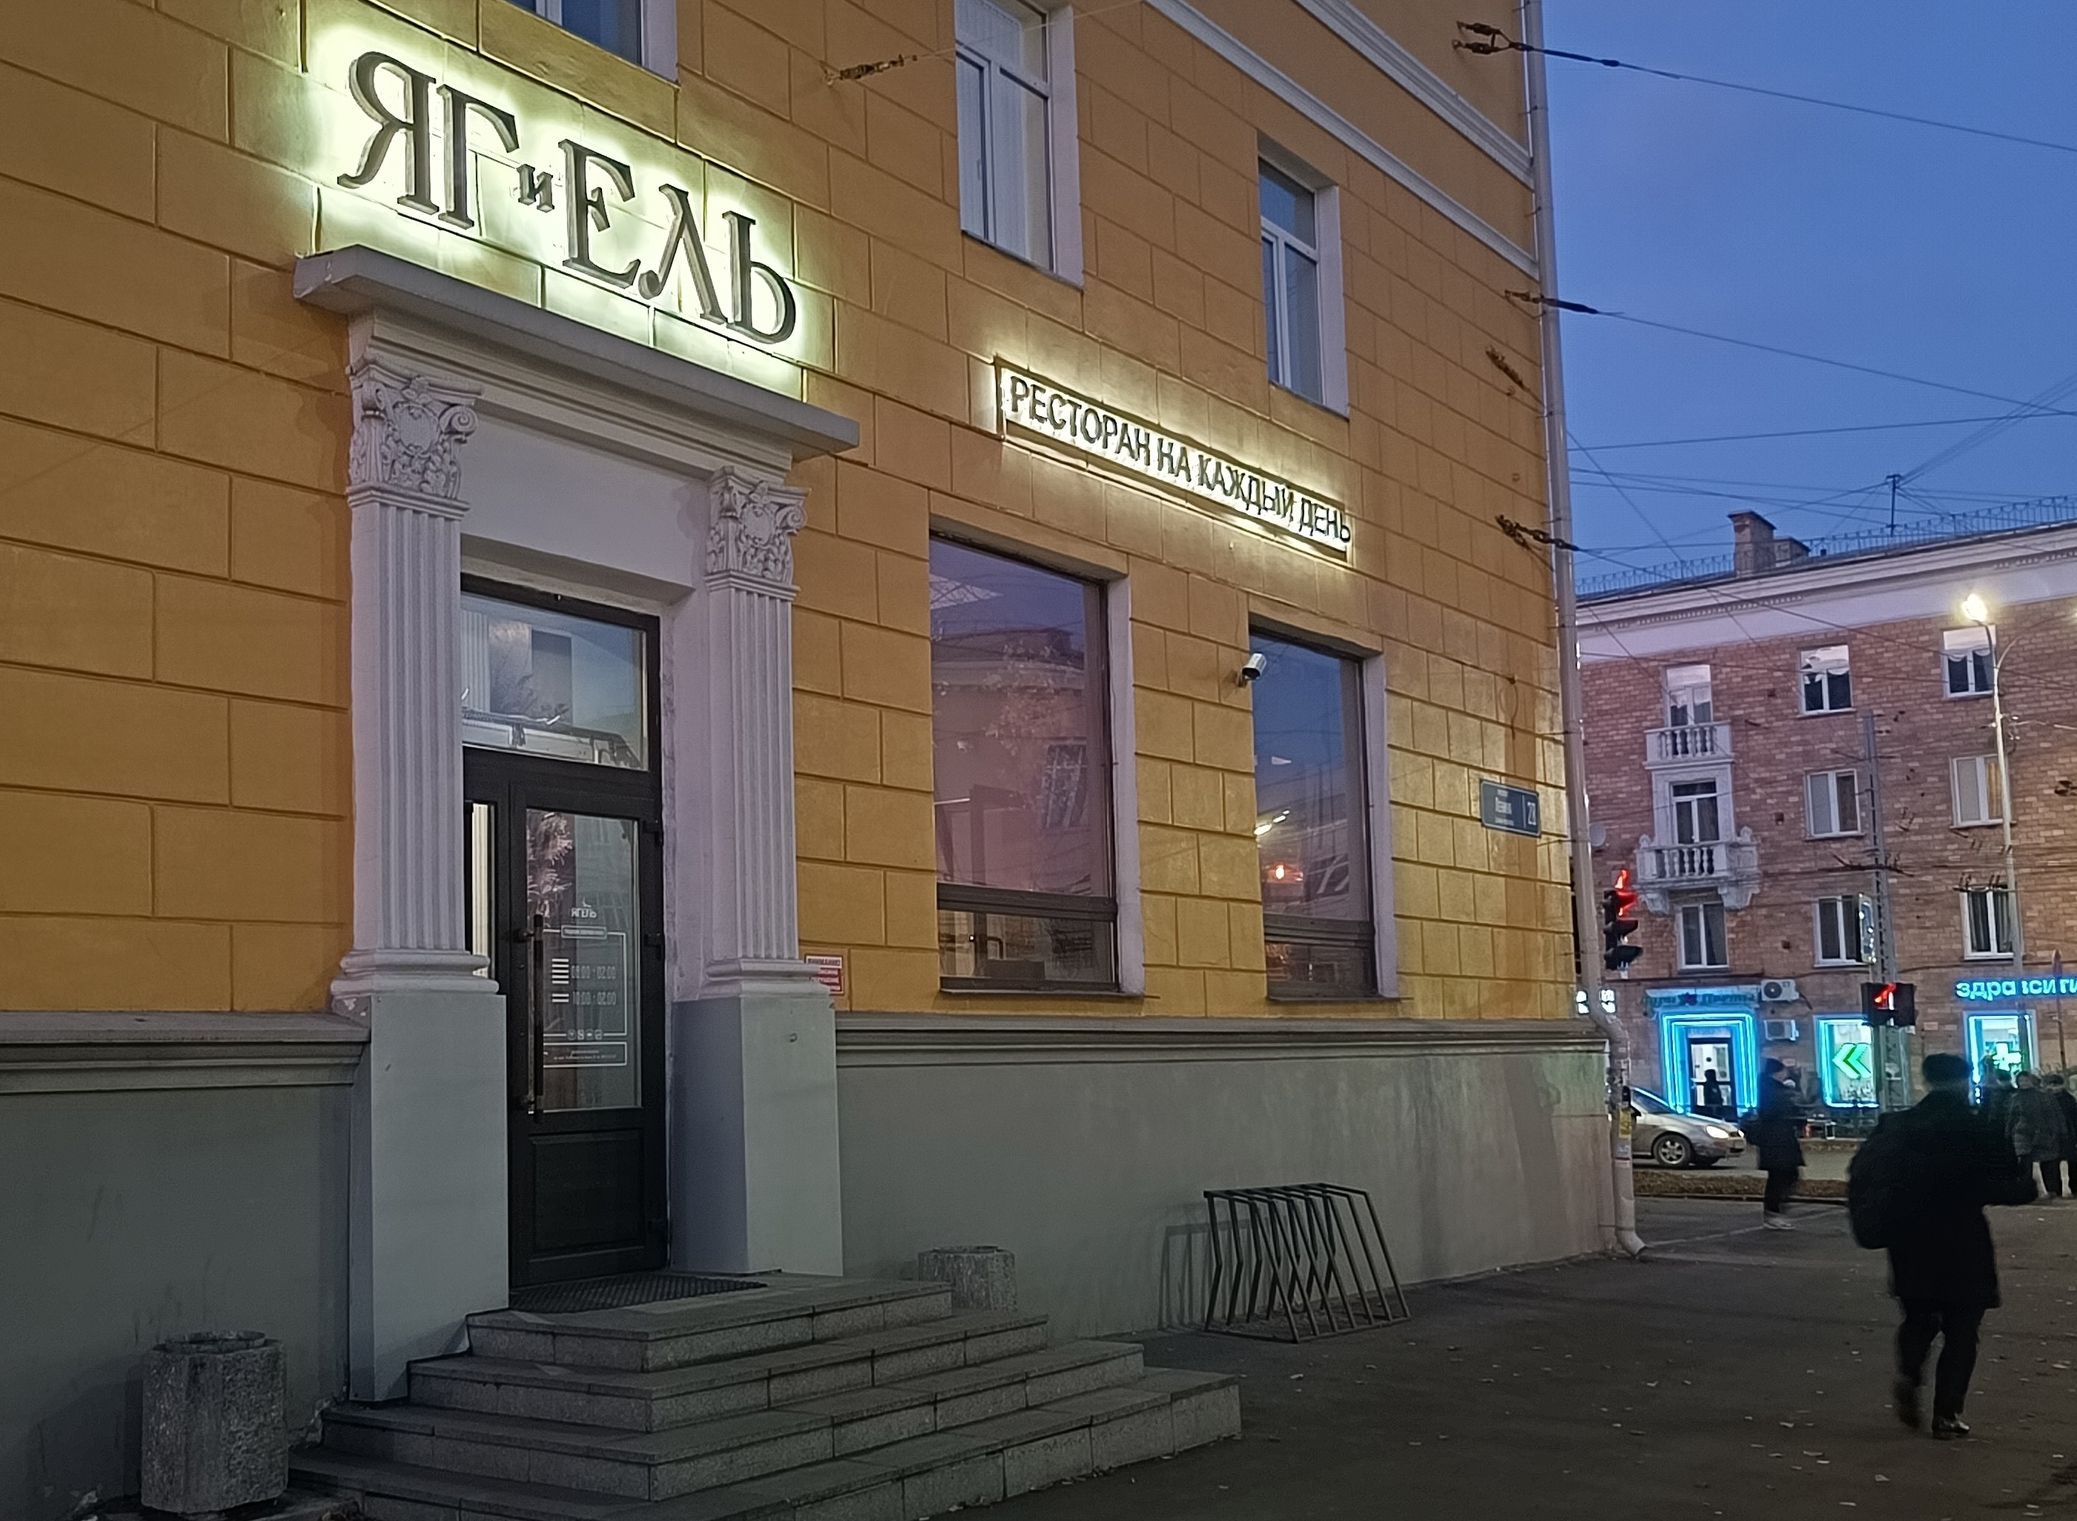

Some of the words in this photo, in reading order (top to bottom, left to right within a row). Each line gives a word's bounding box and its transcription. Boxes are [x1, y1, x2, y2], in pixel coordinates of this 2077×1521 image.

[1010, 375, 1151, 467] РЕСТОРАН
[1157, 437, 1192, 483] НА
[1198, 454, 1296, 524] КАЖДЫЙ
[1299, 497, 1351, 543] ДЕНЬ
